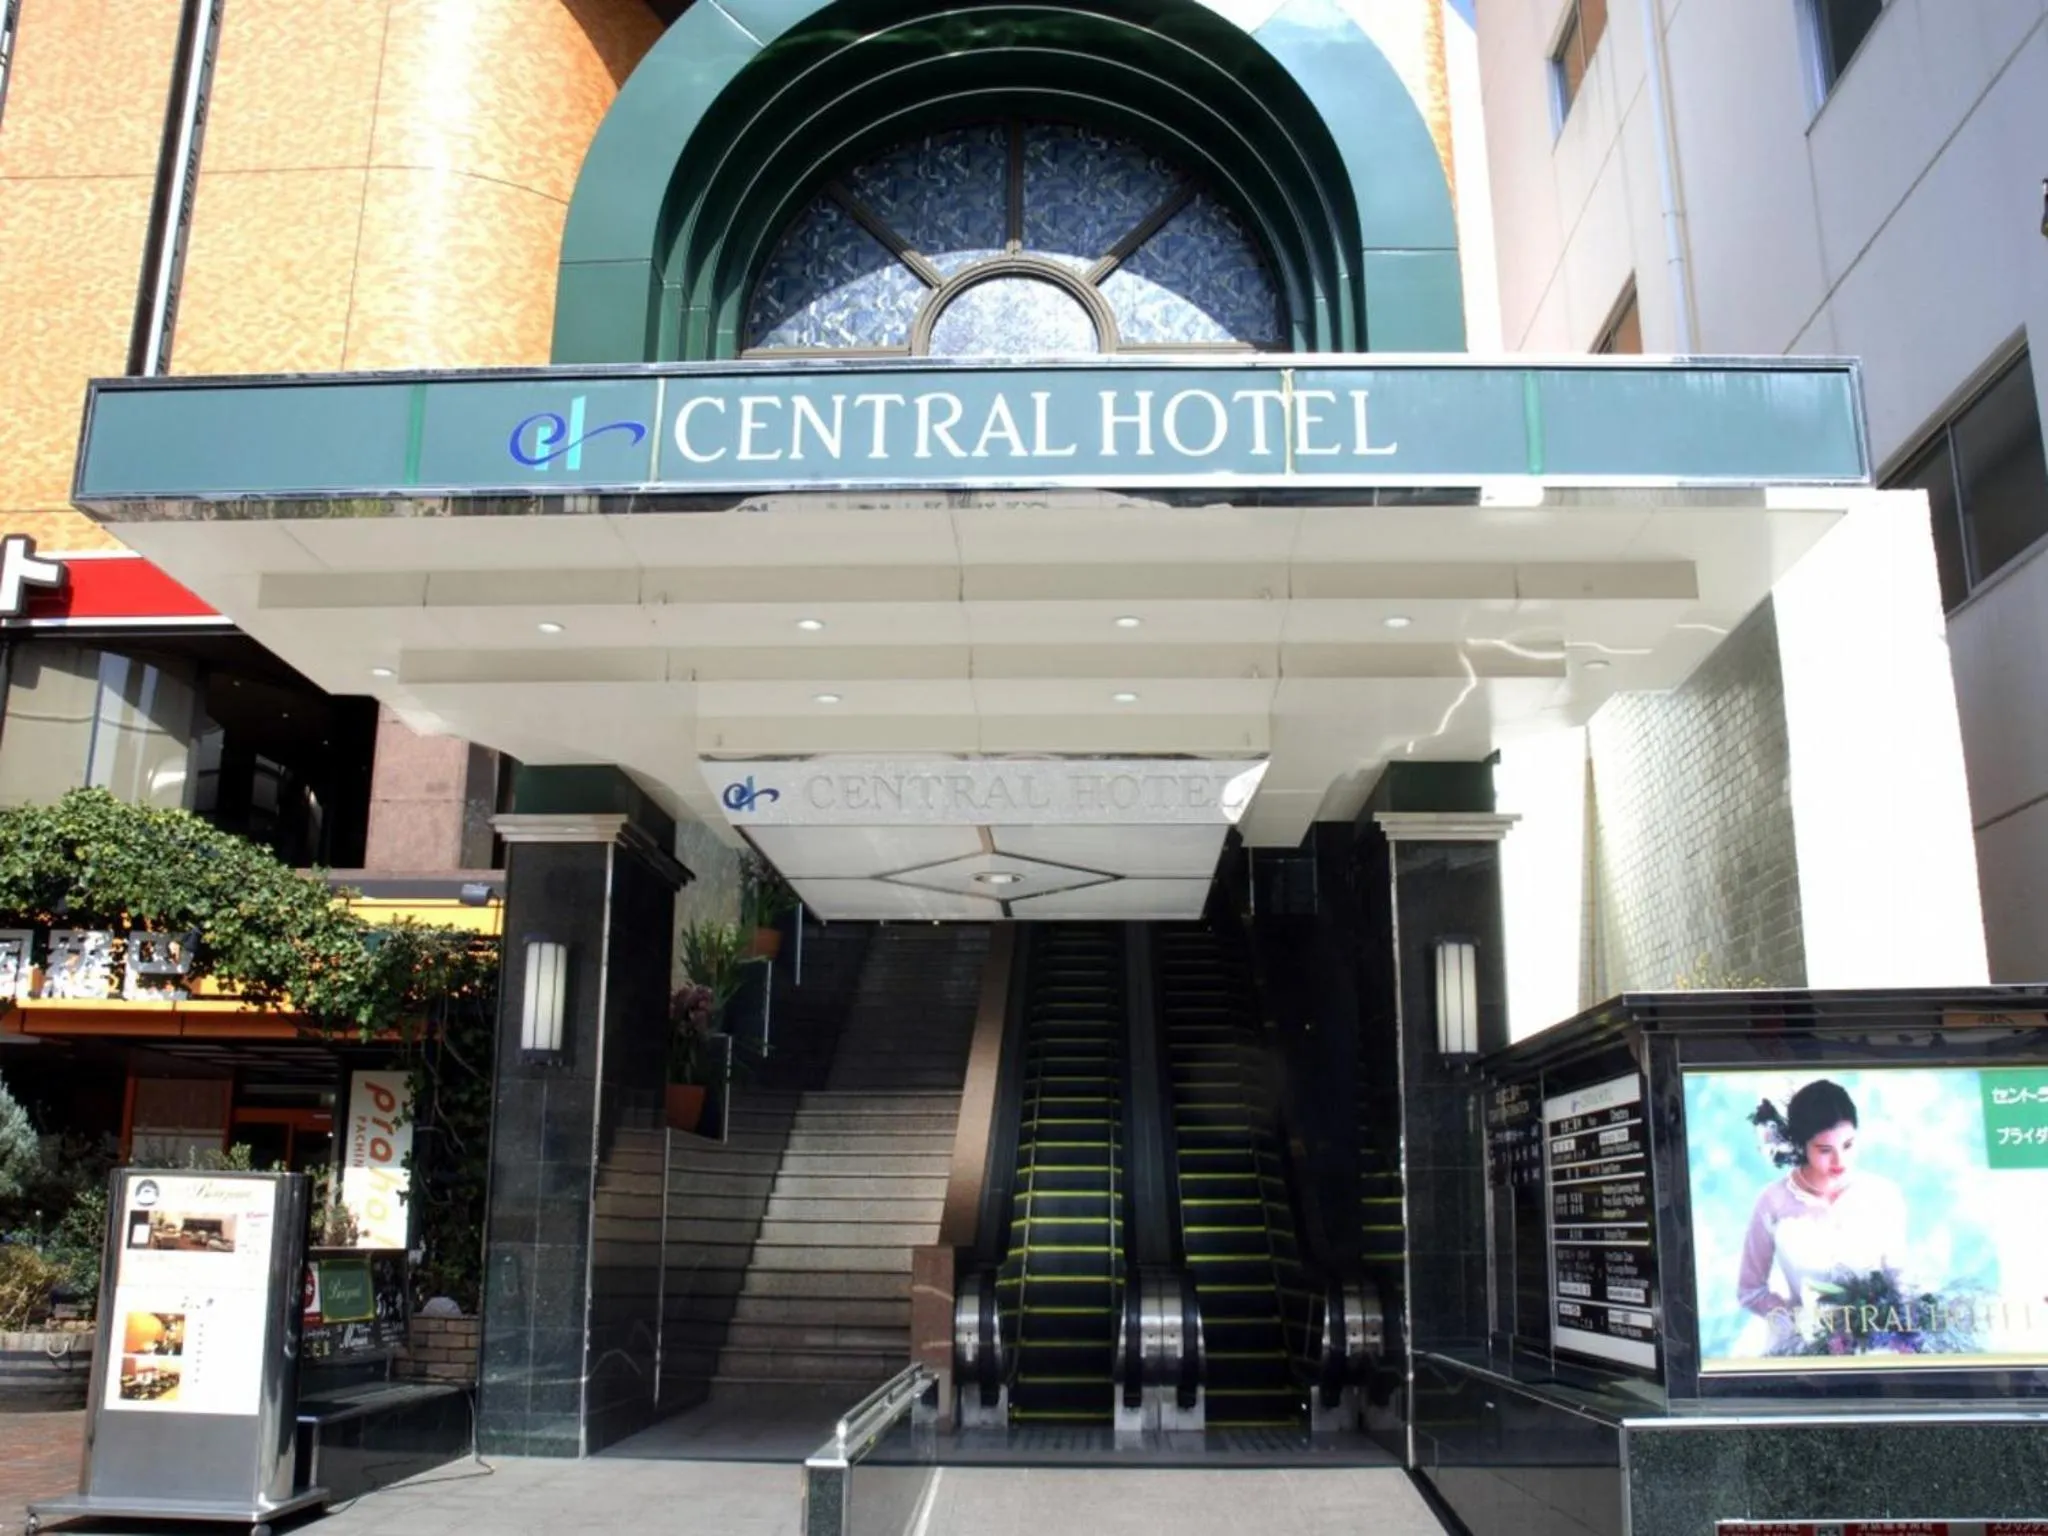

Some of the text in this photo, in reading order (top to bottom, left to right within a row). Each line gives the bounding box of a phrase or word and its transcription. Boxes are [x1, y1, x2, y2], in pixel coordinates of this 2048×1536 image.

[674, 389, 1398, 462] CENTRAL HOTEL
[808, 774, 1243, 810] CENTRAL HOTEL
